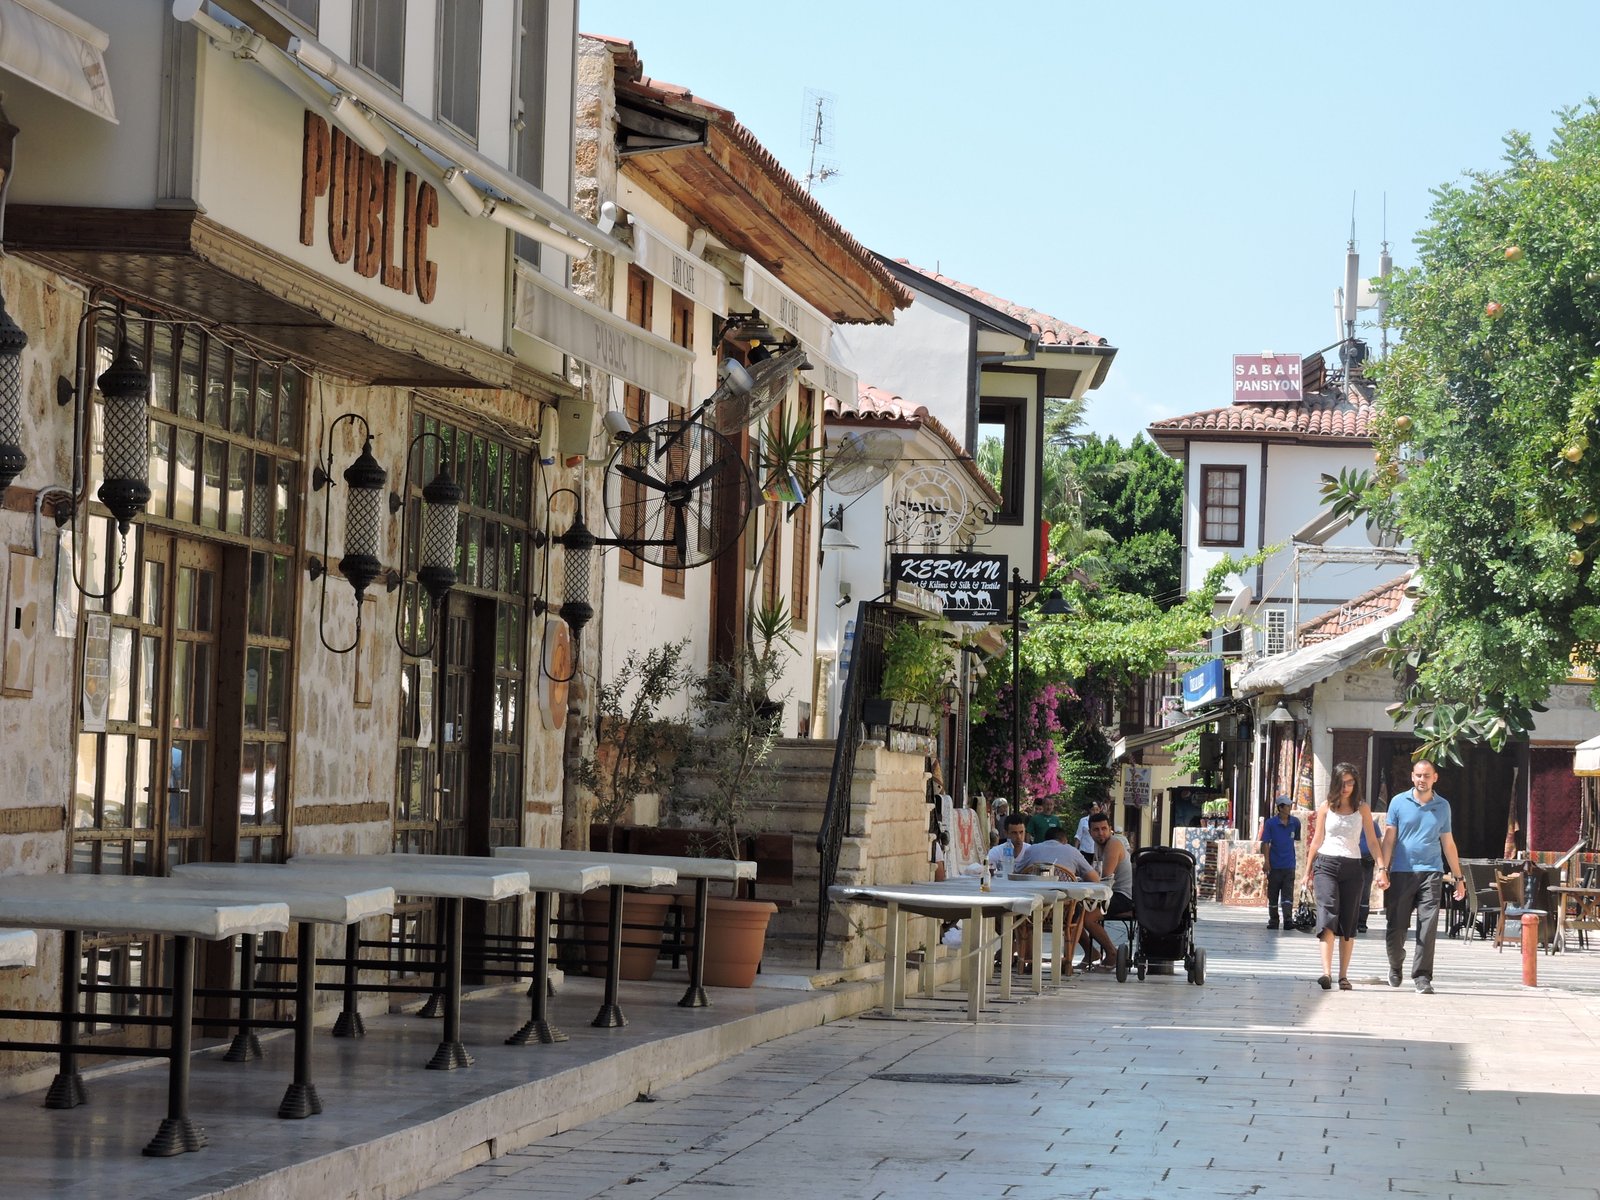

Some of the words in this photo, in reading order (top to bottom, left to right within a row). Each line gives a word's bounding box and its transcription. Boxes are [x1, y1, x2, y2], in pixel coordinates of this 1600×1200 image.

[300, 110, 439, 304] PUBLIC
[672, 255, 682, 286] ART
[595, 323, 627, 371] PUBLIC
[1235, 364, 1299, 375] SABAH
[909, 496, 949, 511] ART
[901, 559, 1001, 580] KERVAN
[920, 580, 928, 589] &
[928, 581, 948, 589] Kilims
[949, 581, 957, 589] &
[958, 581, 971, 589] Silk
[972, 581, 979, 589] &
[981, 582, 1001, 590] Textile
